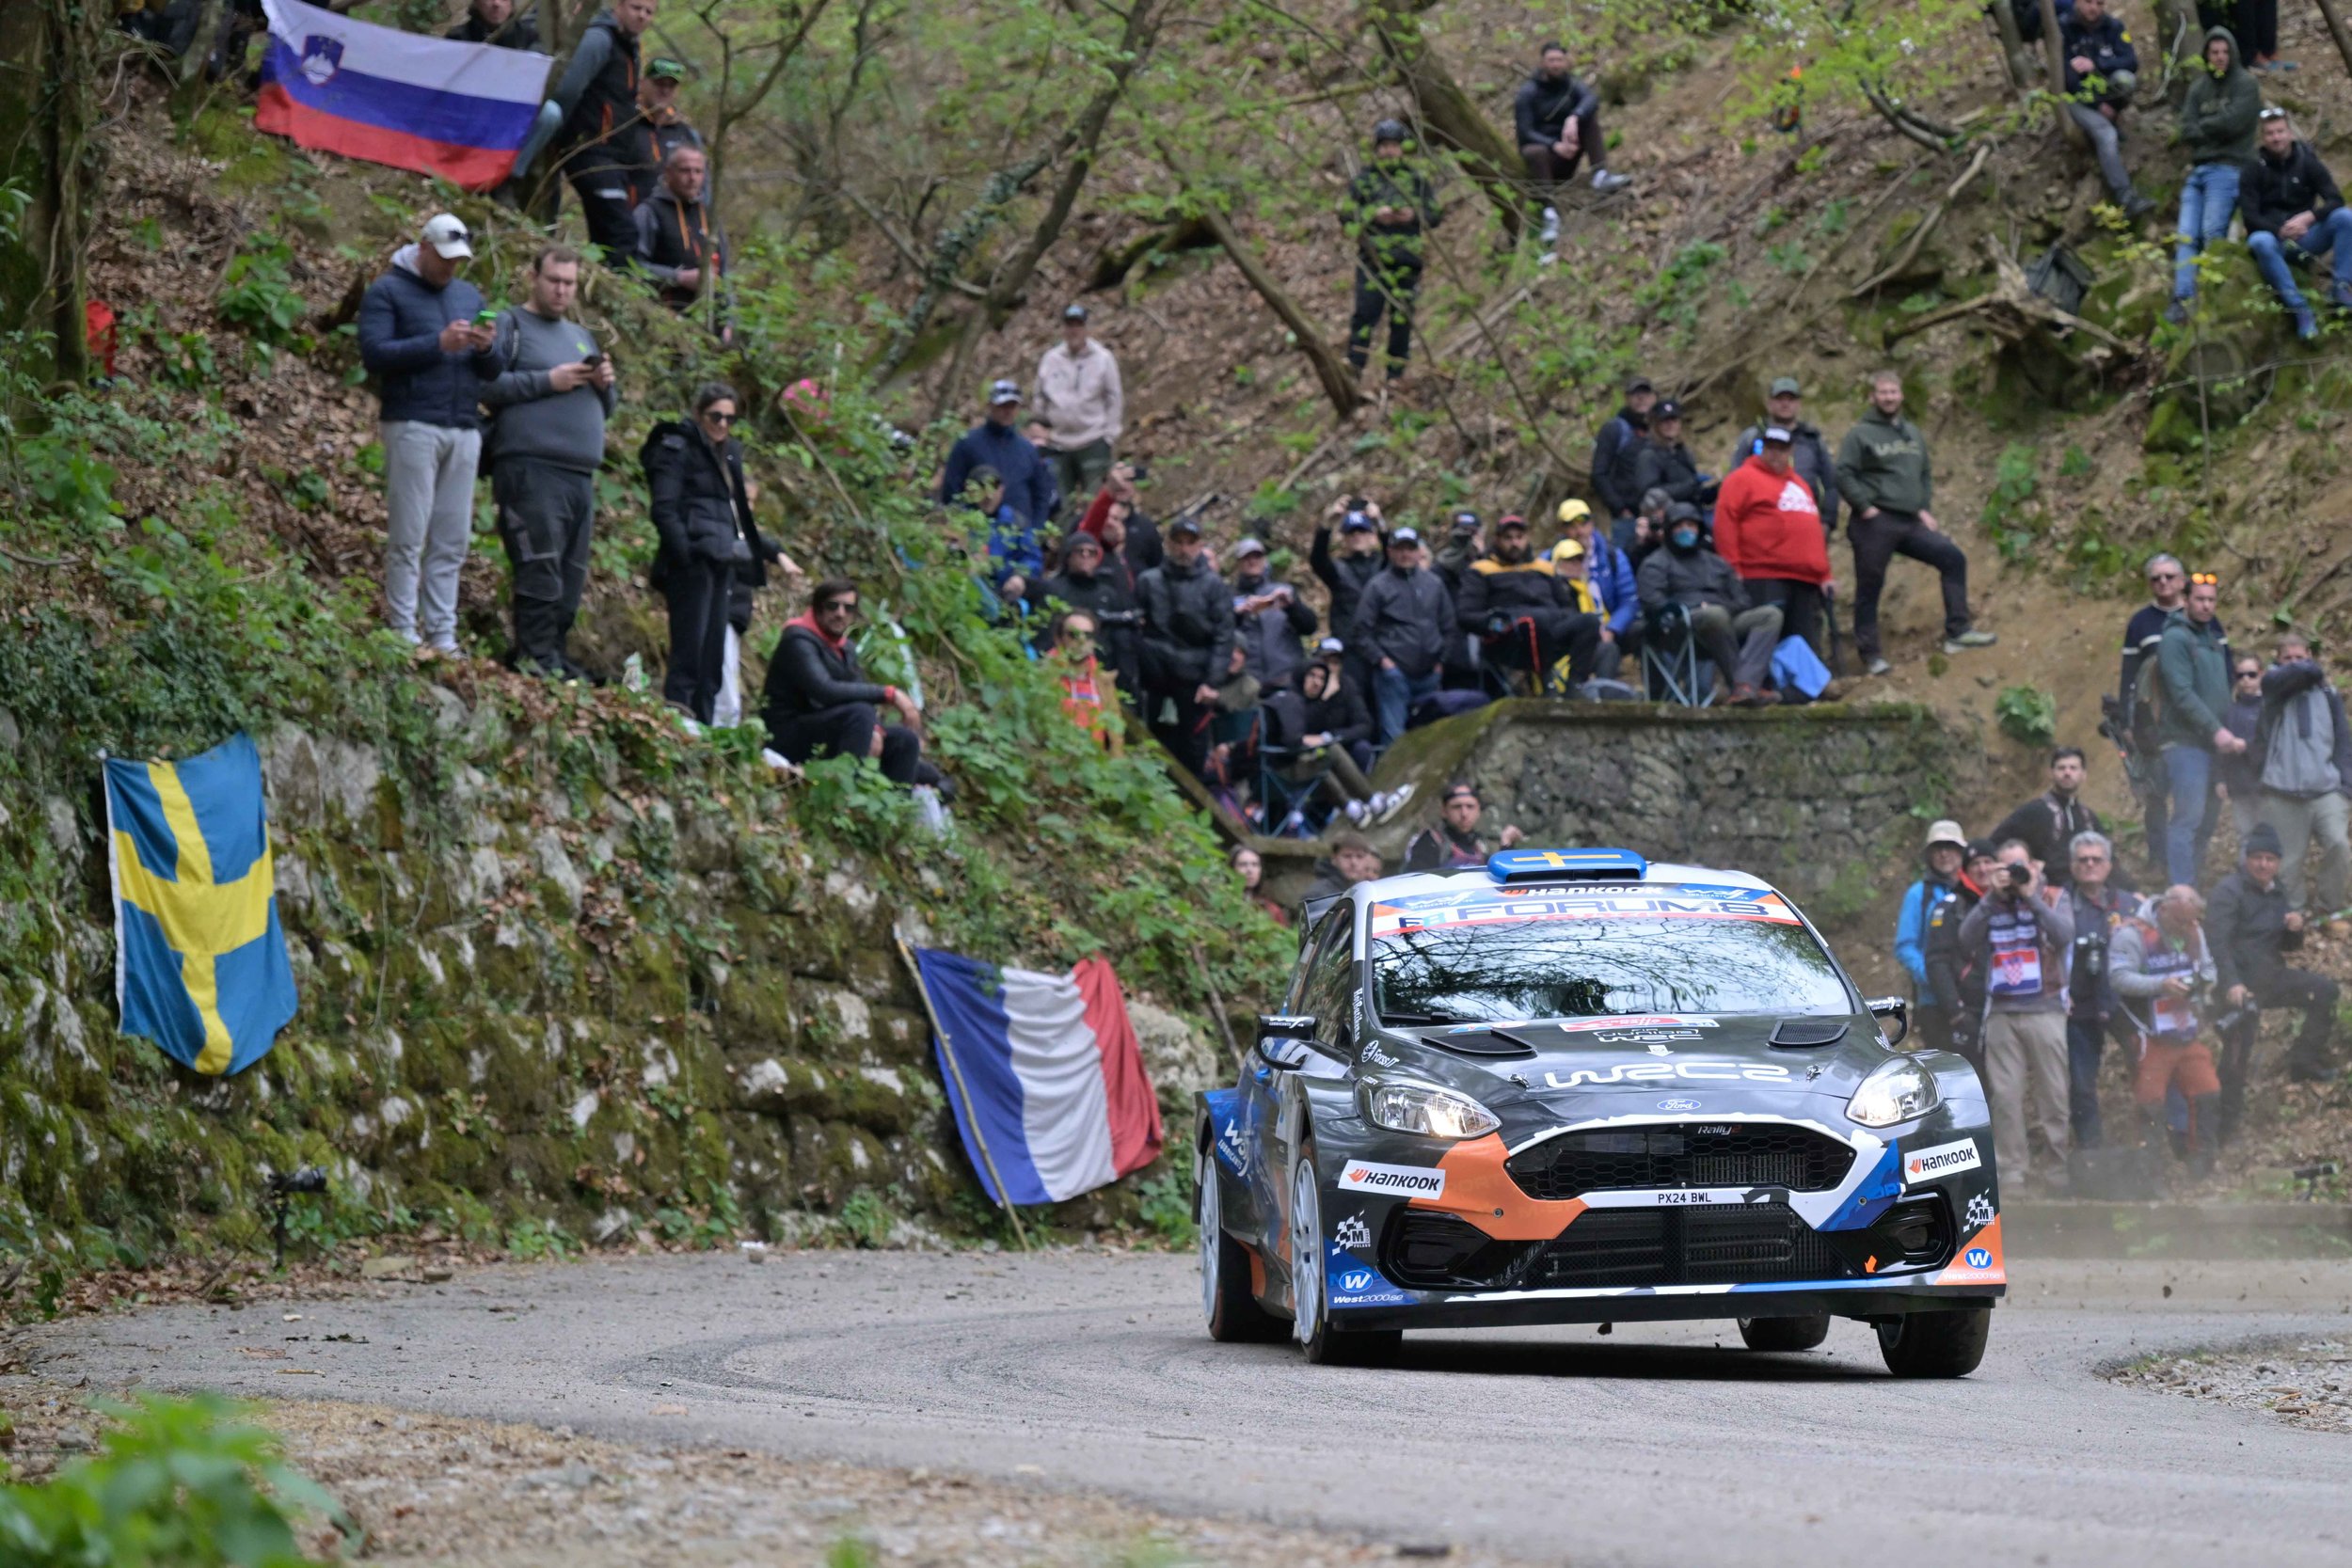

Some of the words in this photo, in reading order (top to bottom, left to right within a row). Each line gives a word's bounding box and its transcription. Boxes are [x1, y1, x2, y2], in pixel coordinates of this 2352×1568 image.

[1456, 900, 1770, 920] FORUM8
[1544, 1063, 1792, 1088] WRC2
[1664, 1099, 1694, 1110] Ford
[1697, 1125, 1742, 1135] Rally2
[1658, 1193, 1687, 1204] PX24
[1691, 1193, 1712, 1203] BWL
[1968, 1250, 1991, 1266] W
[1345, 1273, 1372, 1289] W
[1333, 1293, 1404, 1304] West2000.se
